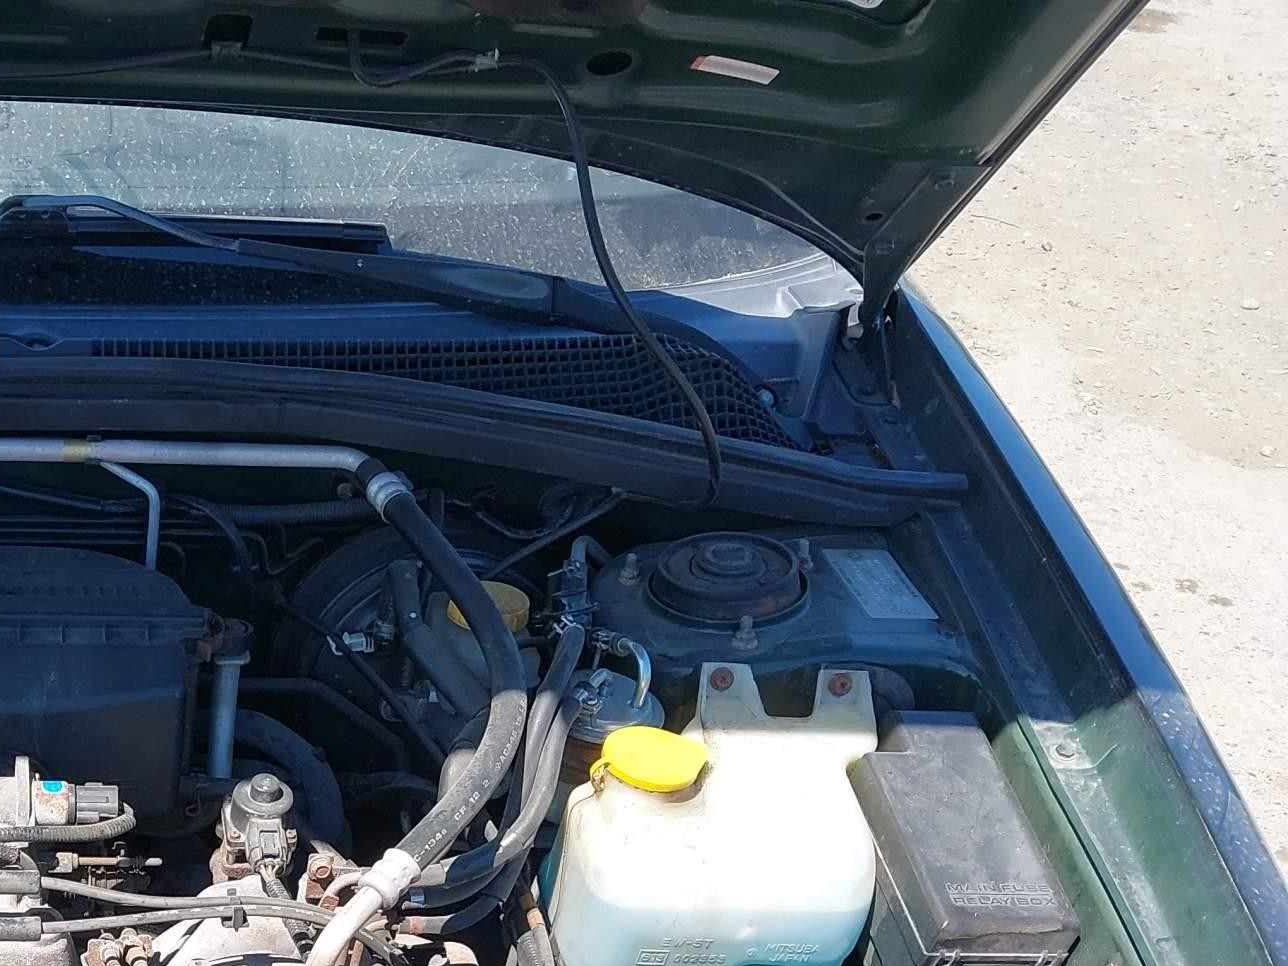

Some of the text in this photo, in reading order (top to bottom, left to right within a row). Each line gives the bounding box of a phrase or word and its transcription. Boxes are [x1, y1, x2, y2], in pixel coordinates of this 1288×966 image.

[945, 883, 1053, 894] MAIN FUSE
[951, 896, 1057, 907] RELAY BOX
[764, 943, 820, 955] MITSUBA
[767, 954, 811, 963] JAPAN
